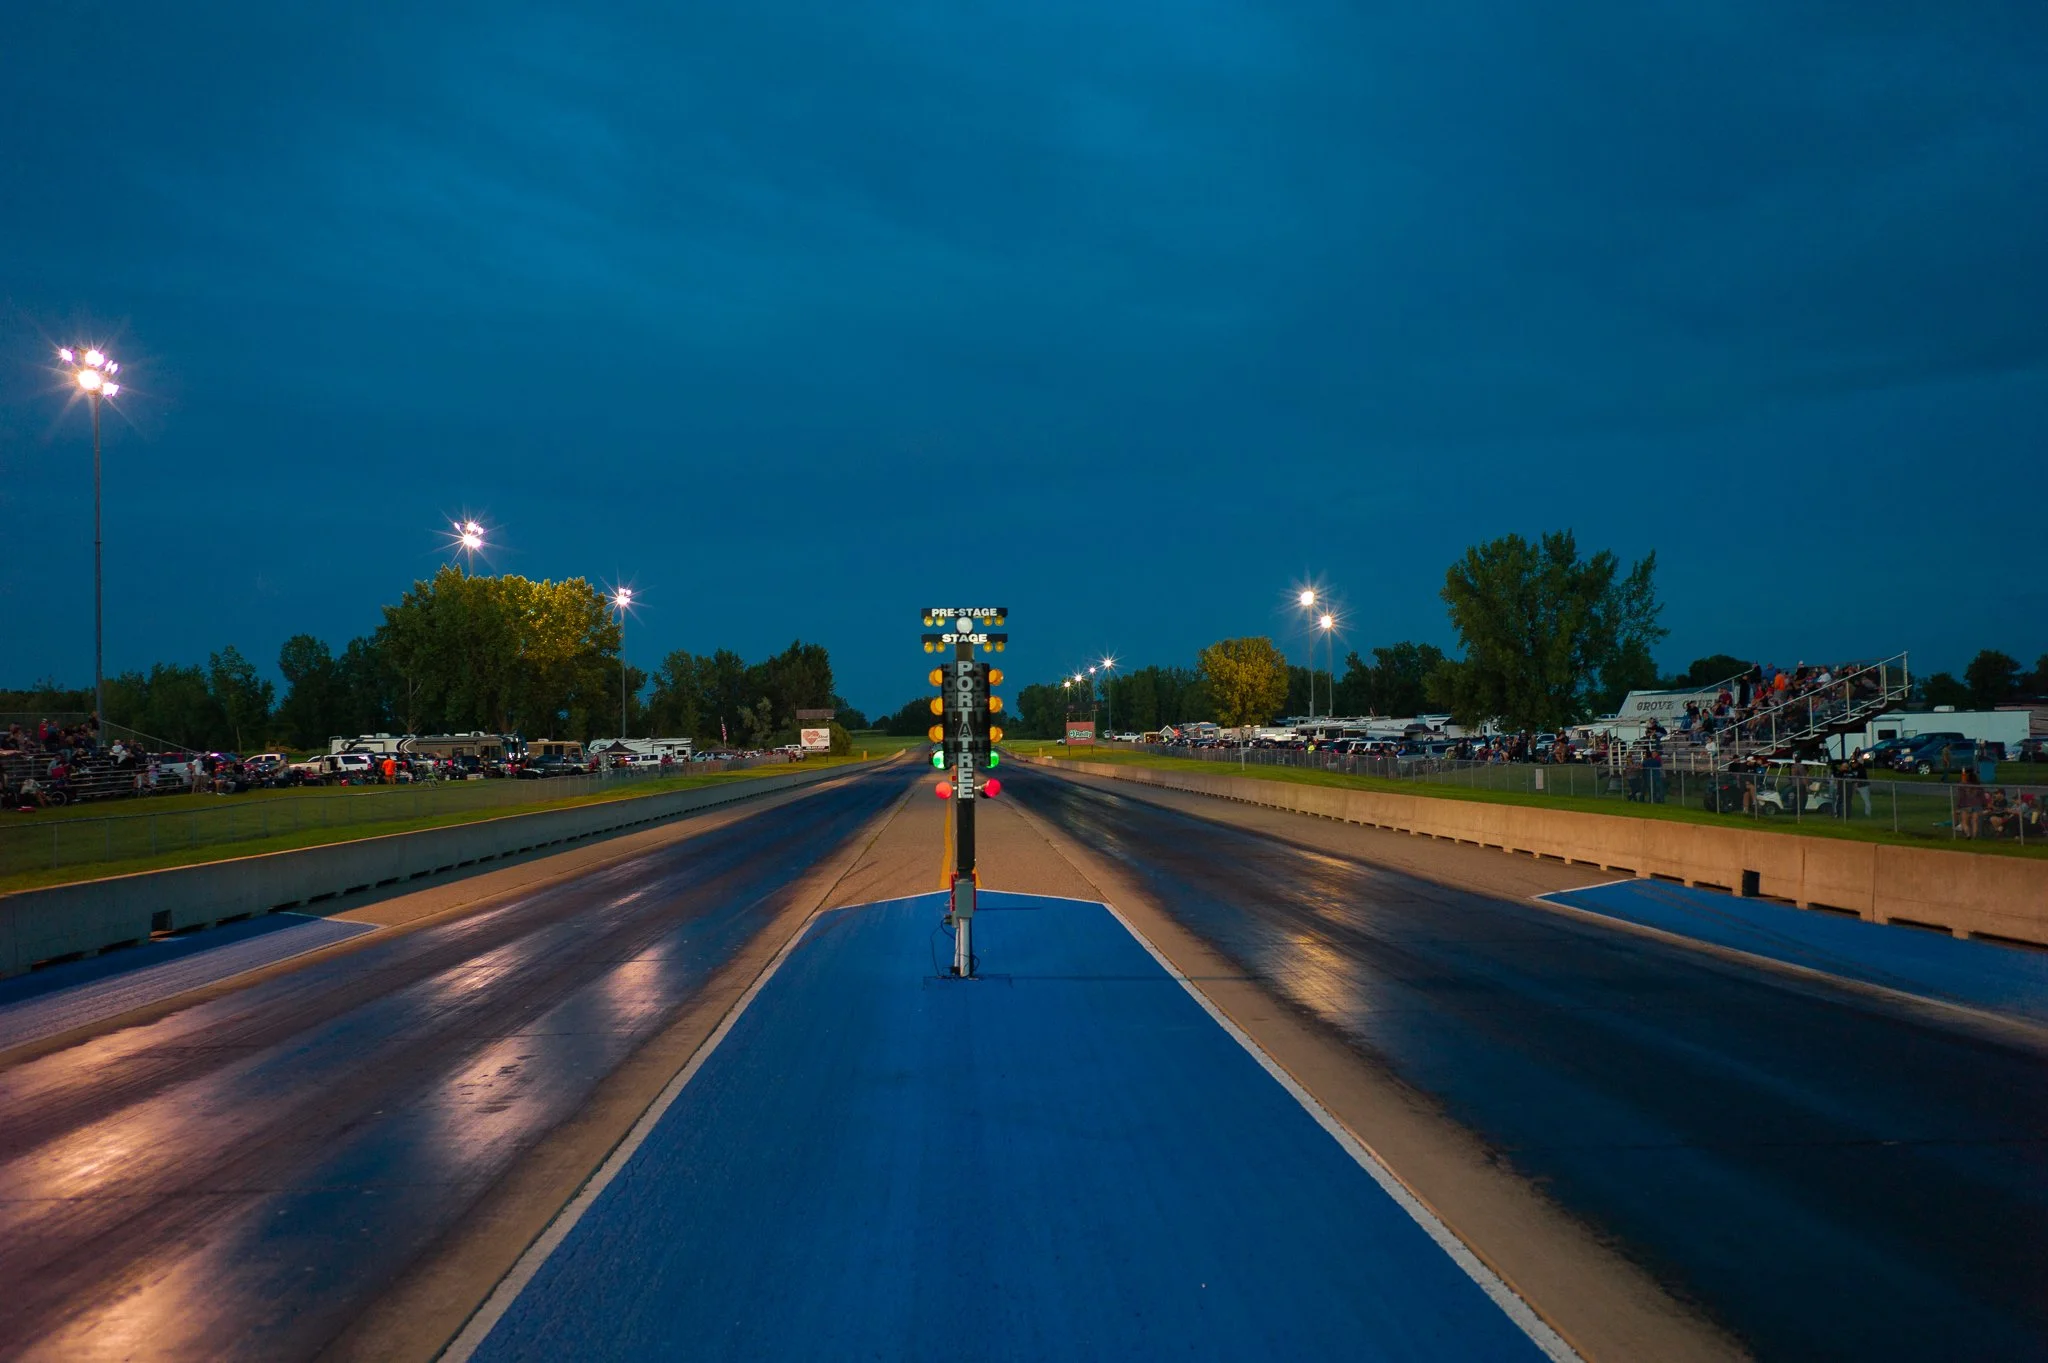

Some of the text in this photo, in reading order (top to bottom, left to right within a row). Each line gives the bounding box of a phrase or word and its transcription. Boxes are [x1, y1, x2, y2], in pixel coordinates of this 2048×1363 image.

[931, 608, 997, 617] PRE-STAGE
[942, 634, 987, 643] STAGE
[1637, 701, 1673, 711] GROVE
